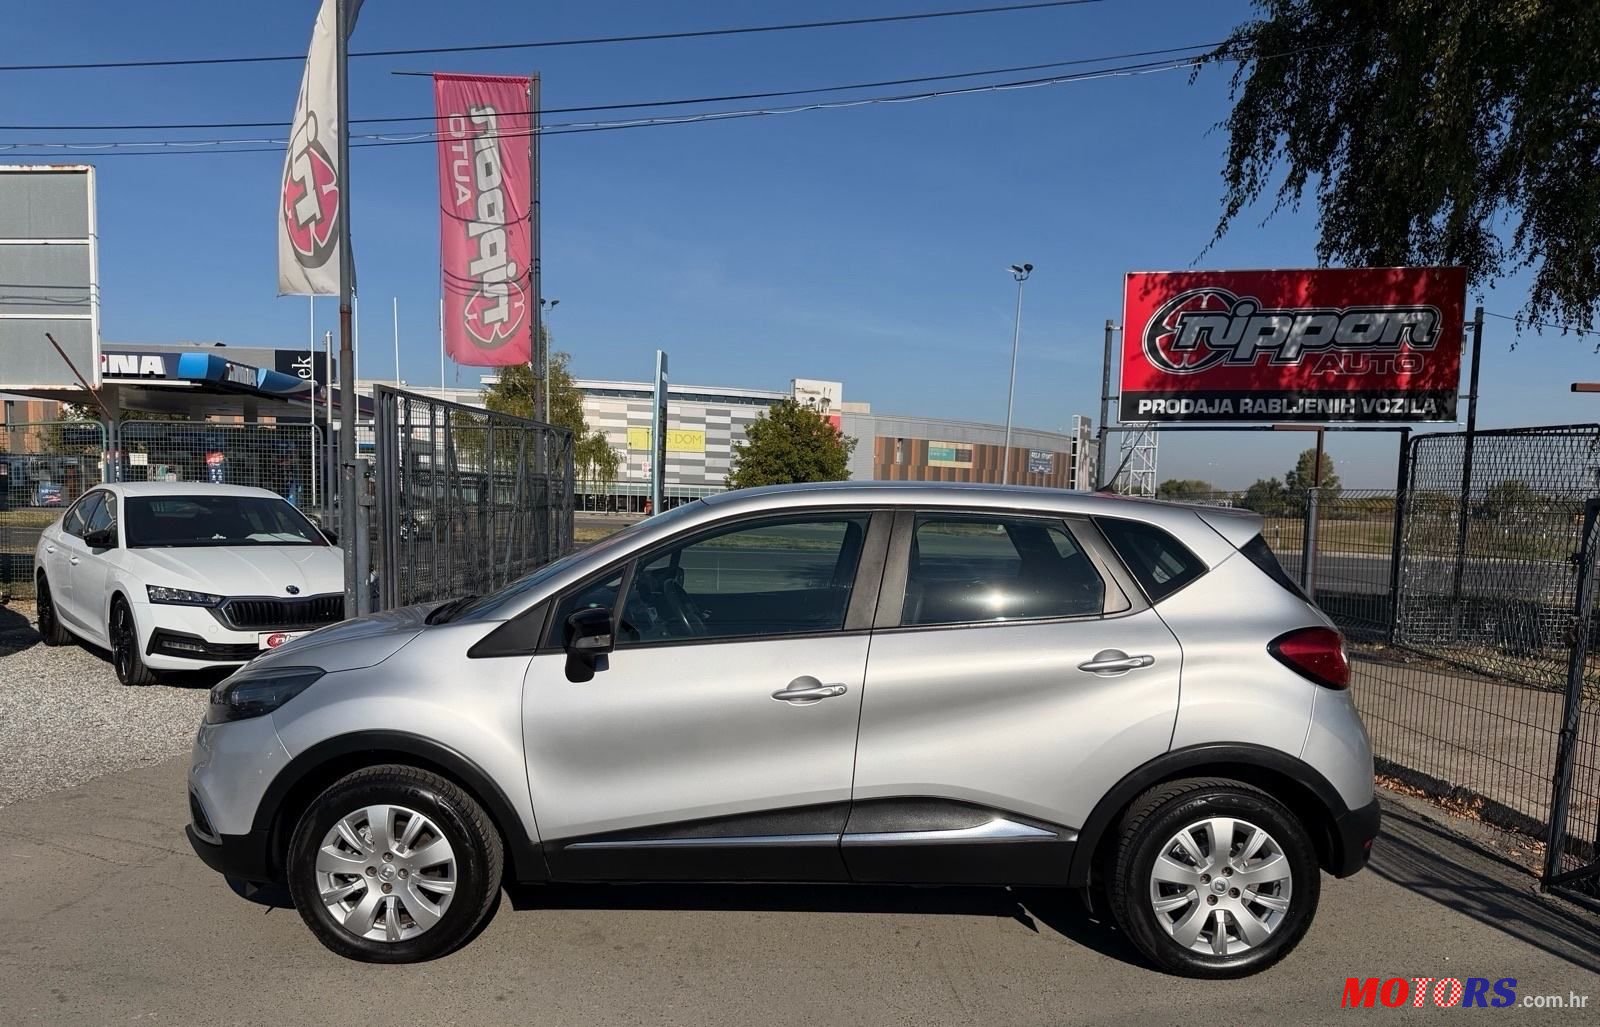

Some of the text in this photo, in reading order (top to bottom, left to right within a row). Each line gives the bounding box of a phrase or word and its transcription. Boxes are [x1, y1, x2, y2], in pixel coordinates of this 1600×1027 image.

[1174, 297, 1441, 365] nippon
[1311, 353, 1425, 375] AUTO
[1138, 397, 1437, 415] PRODAJA RABLJENIH VOZILA
[674, 433, 702, 445] DOM
